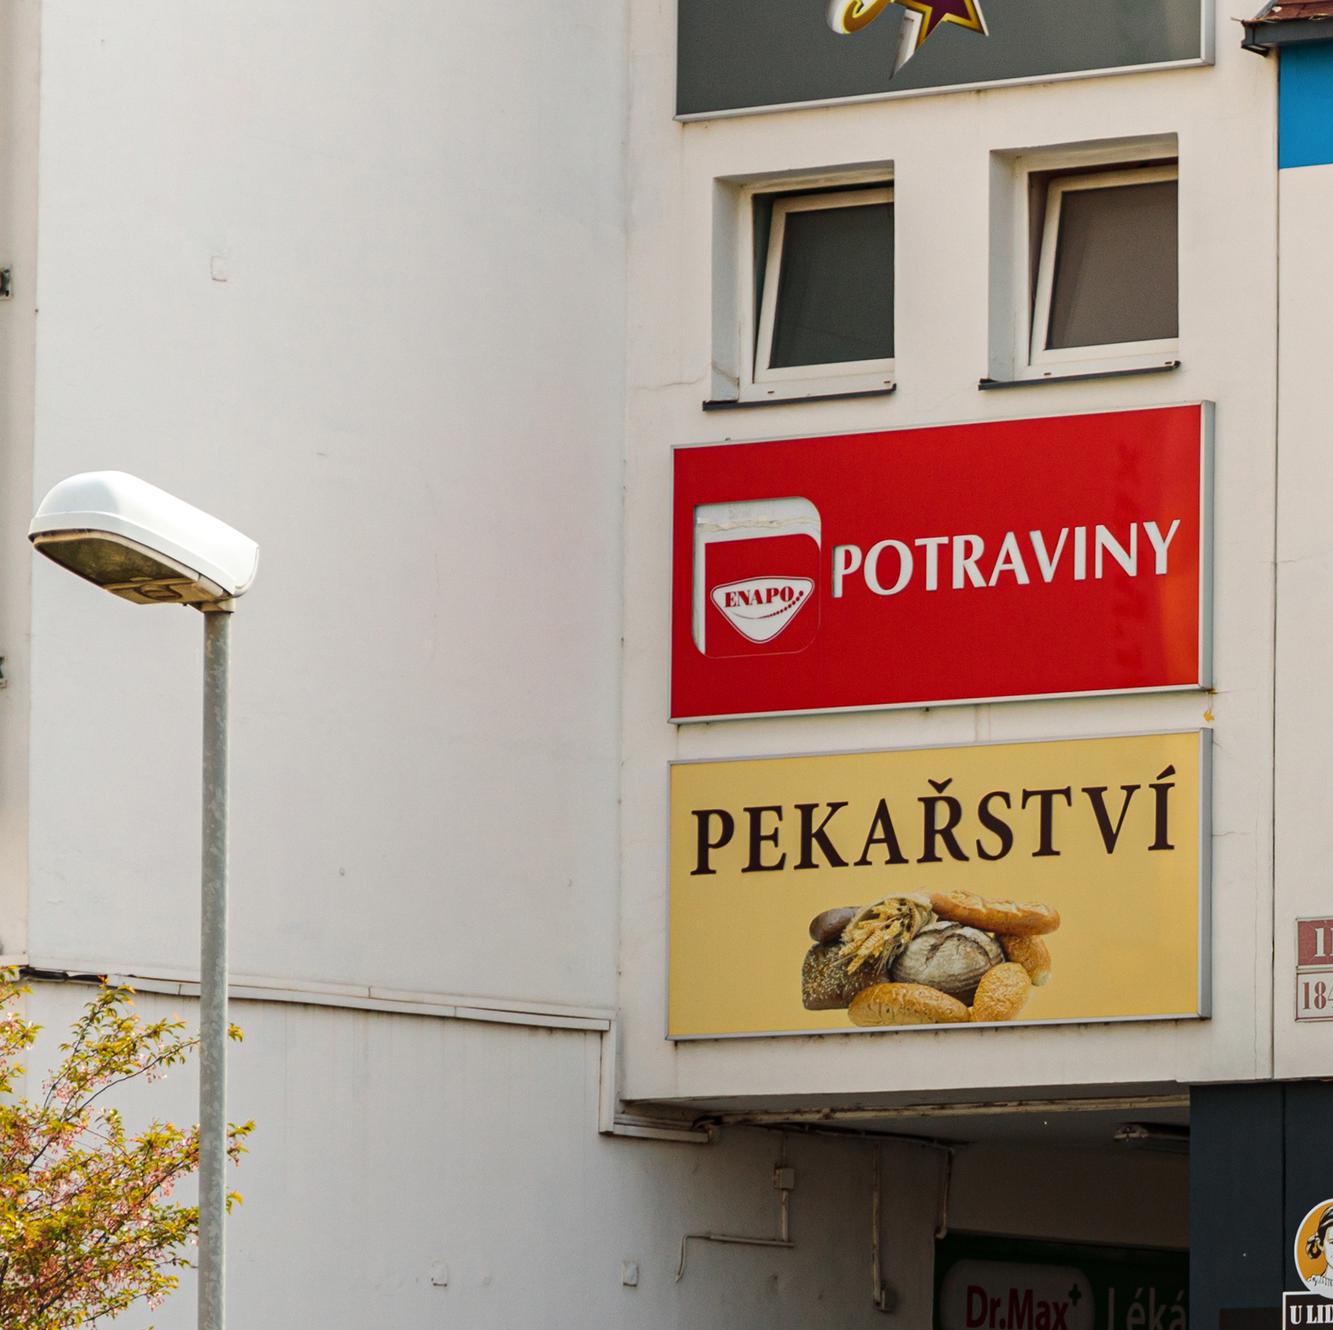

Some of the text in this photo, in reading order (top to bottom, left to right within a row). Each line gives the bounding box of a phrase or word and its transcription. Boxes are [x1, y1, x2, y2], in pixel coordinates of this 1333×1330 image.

[831, 518, 1182, 599] POTRAVINY
[724, 586, 795, 609] ENAPO
[689, 763, 1176, 877] PEKAŘSTVÍ
[1289, 1304, 1303, 1325] U
